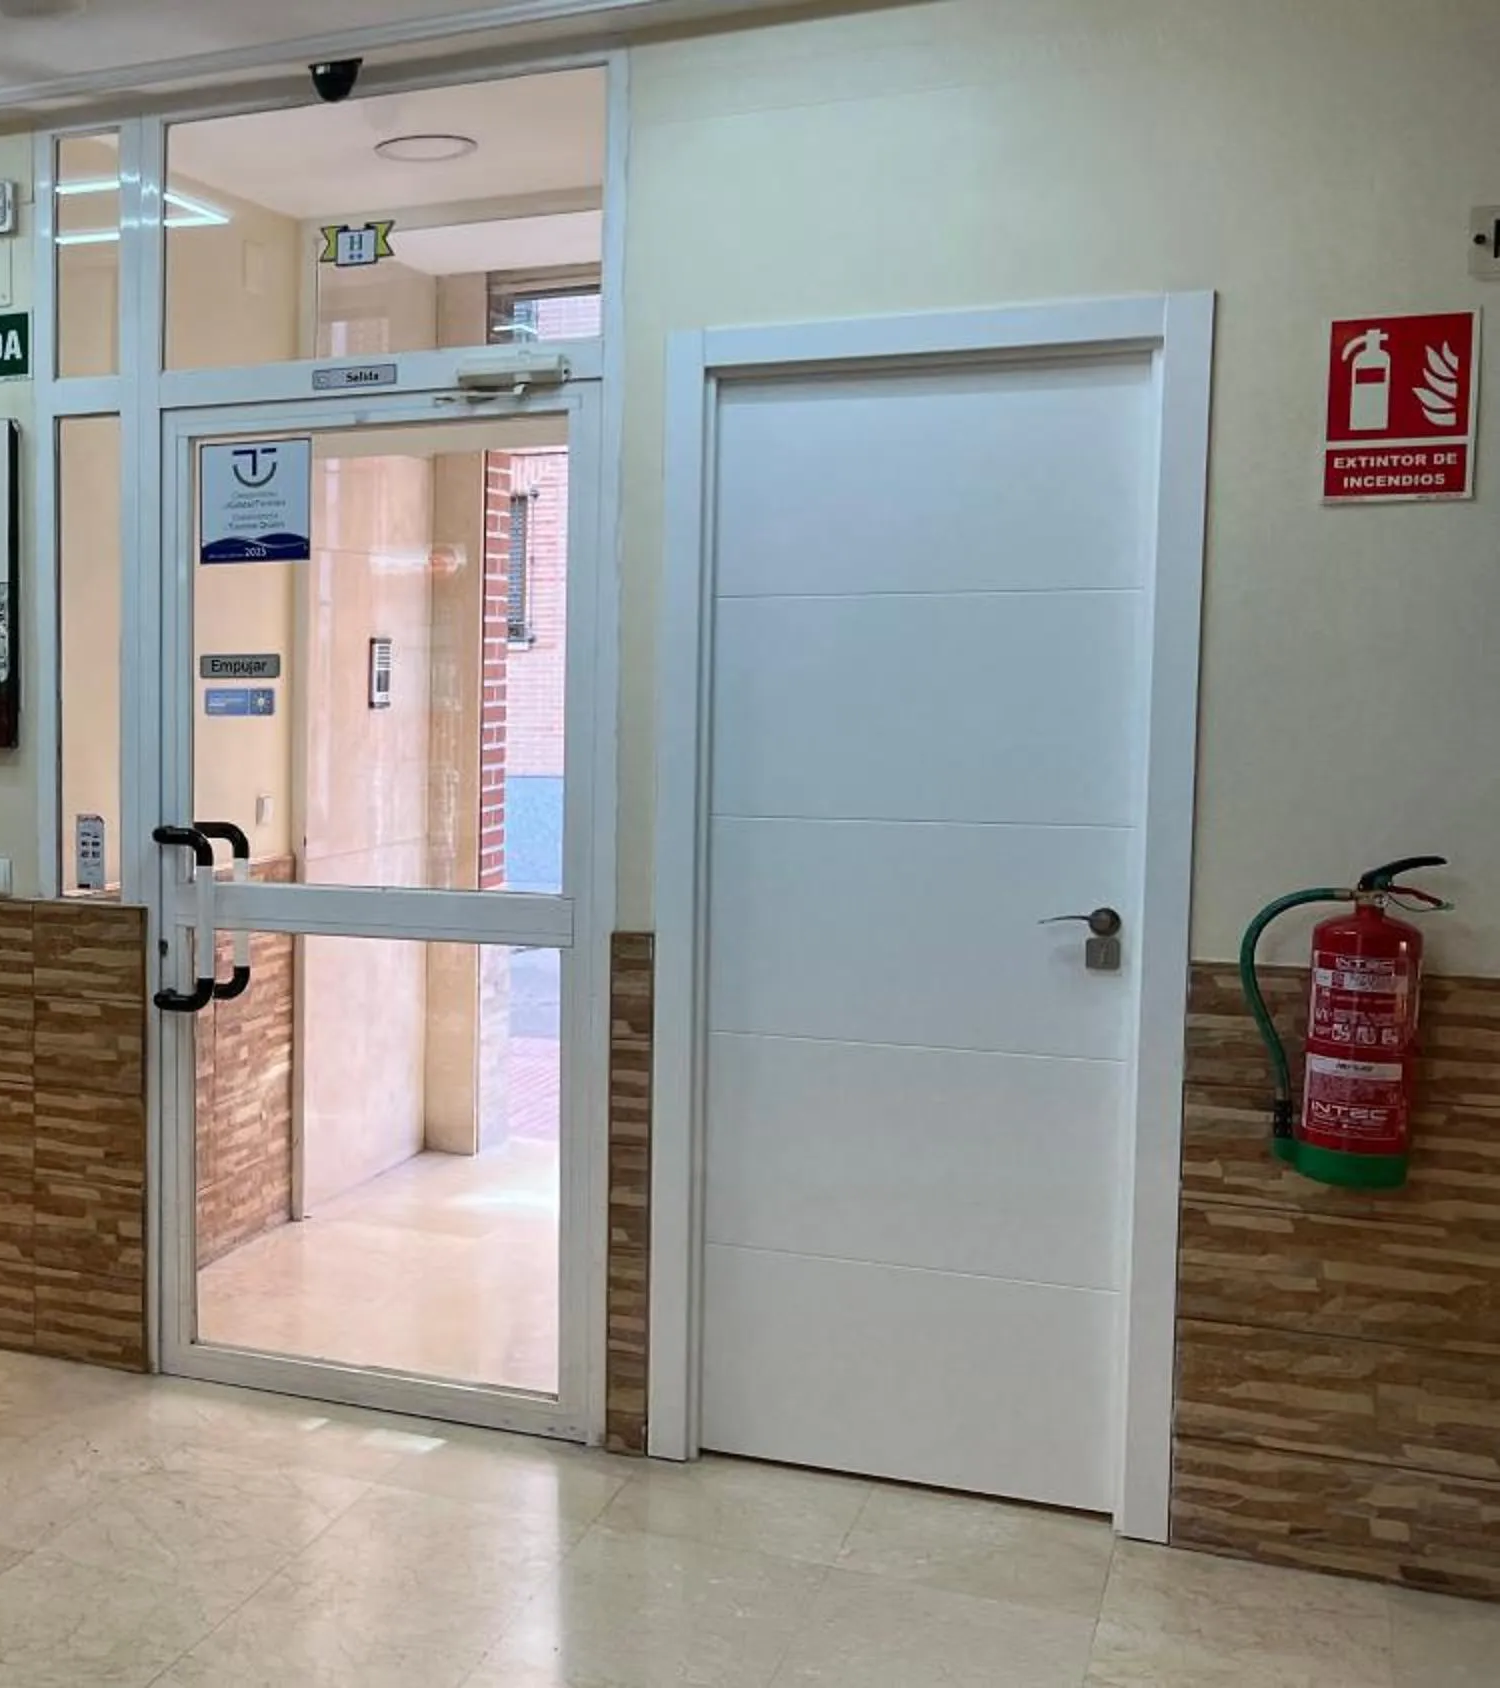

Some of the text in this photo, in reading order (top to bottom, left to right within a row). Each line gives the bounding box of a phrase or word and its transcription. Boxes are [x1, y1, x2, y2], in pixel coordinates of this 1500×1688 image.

[348, 234, 364, 250] H
[345, 370, 379, 383] Salida
[1333, 452, 1458, 469] EXTINTOR DE
[1343, 473, 1445, 488] INCENDIOS
[211, 659, 267, 674] Empujar
[1311, 1101, 1389, 1120] INTEC
